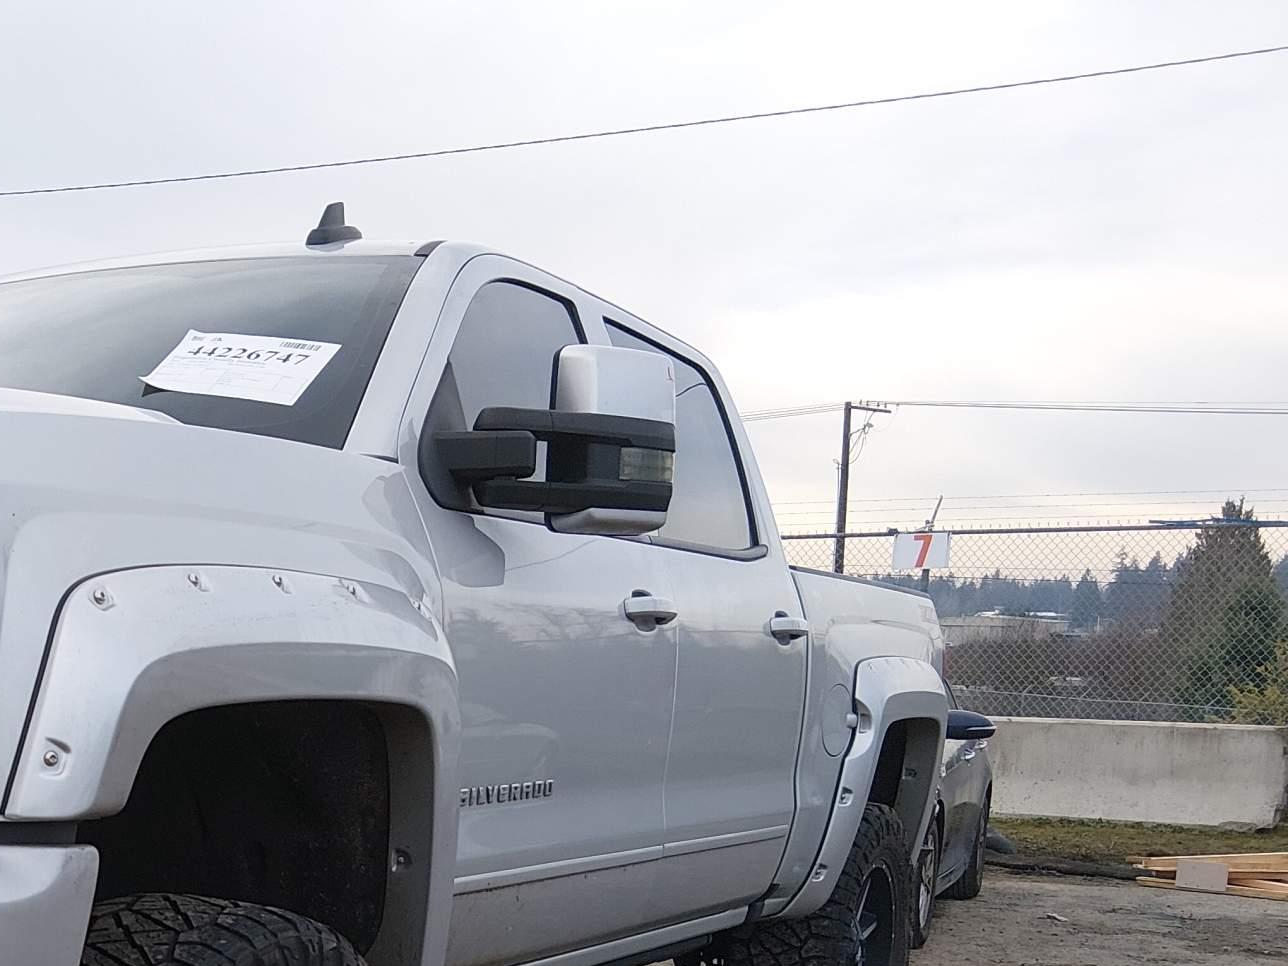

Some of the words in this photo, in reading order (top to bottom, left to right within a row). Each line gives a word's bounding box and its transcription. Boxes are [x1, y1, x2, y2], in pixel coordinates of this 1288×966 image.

[187, 344, 312, 366] 44226747
[912, 534, 934, 568] 7
[459, 779, 555, 807] SILVERADO
